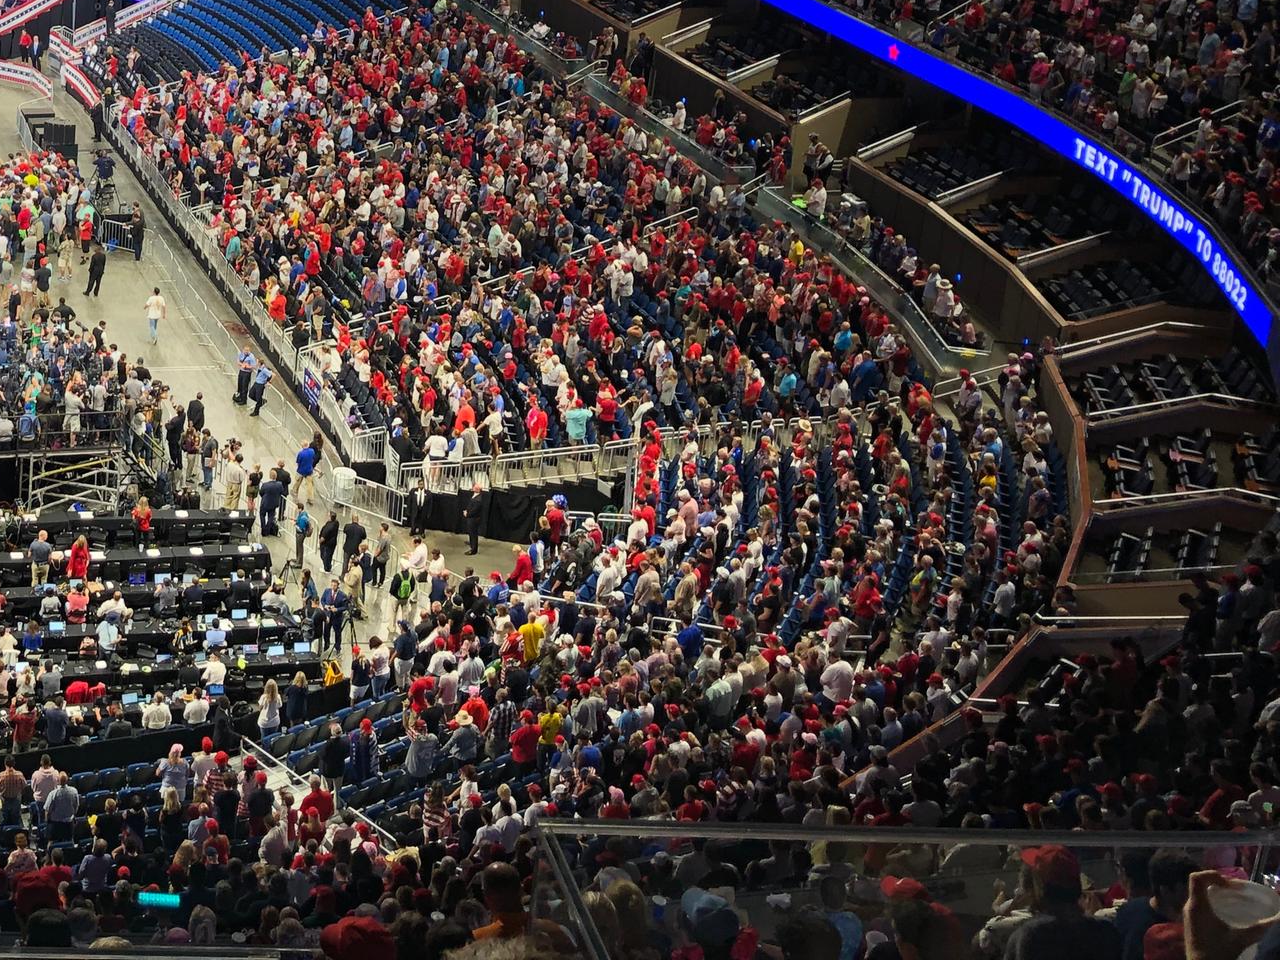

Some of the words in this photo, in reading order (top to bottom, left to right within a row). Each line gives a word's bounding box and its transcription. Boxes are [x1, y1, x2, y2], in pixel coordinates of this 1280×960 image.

[1074, 137, 1119, 183] TEXT
[1195, 228, 1213, 263] TO
[1213, 251, 1248, 312] 88022
